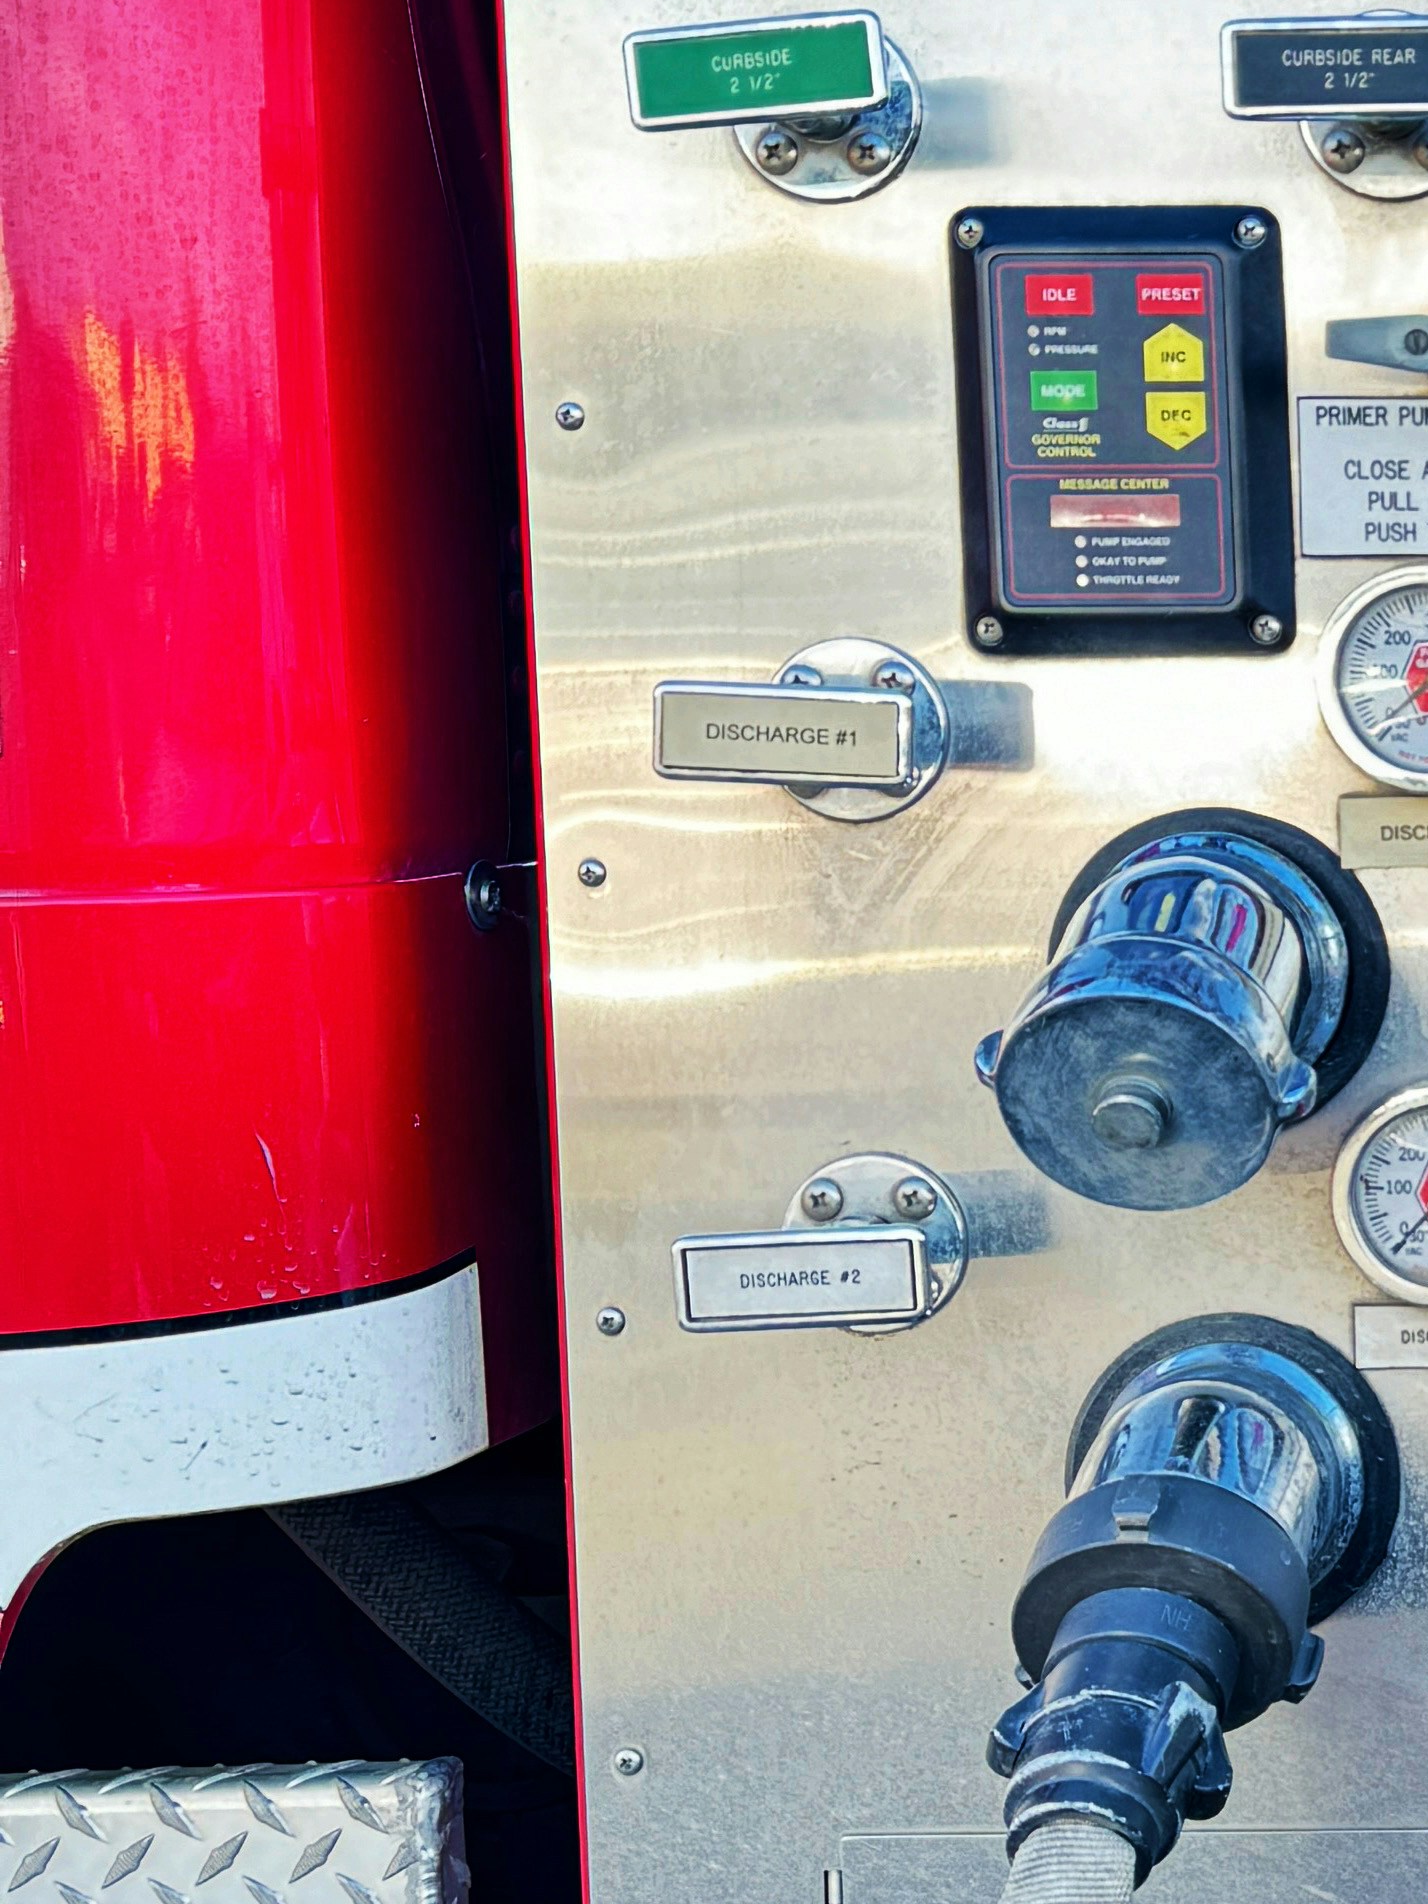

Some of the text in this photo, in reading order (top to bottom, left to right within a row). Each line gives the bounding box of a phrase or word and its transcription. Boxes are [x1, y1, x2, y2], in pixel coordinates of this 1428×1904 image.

[1042, 287, 1077, 301] IDLE
[1141, 287, 1201, 301] PRESET
[1315, 406, 1388, 427] PRIMER
[1344, 460, 1410, 480] CLOSE
[1368, 491, 1423, 511] PULL
[1364, 522, 1418, 542] PUSH
[705, 722, 857, 746] DISCHARGE #1
[740, 1270, 861, 1287] DISCHARGE #2
